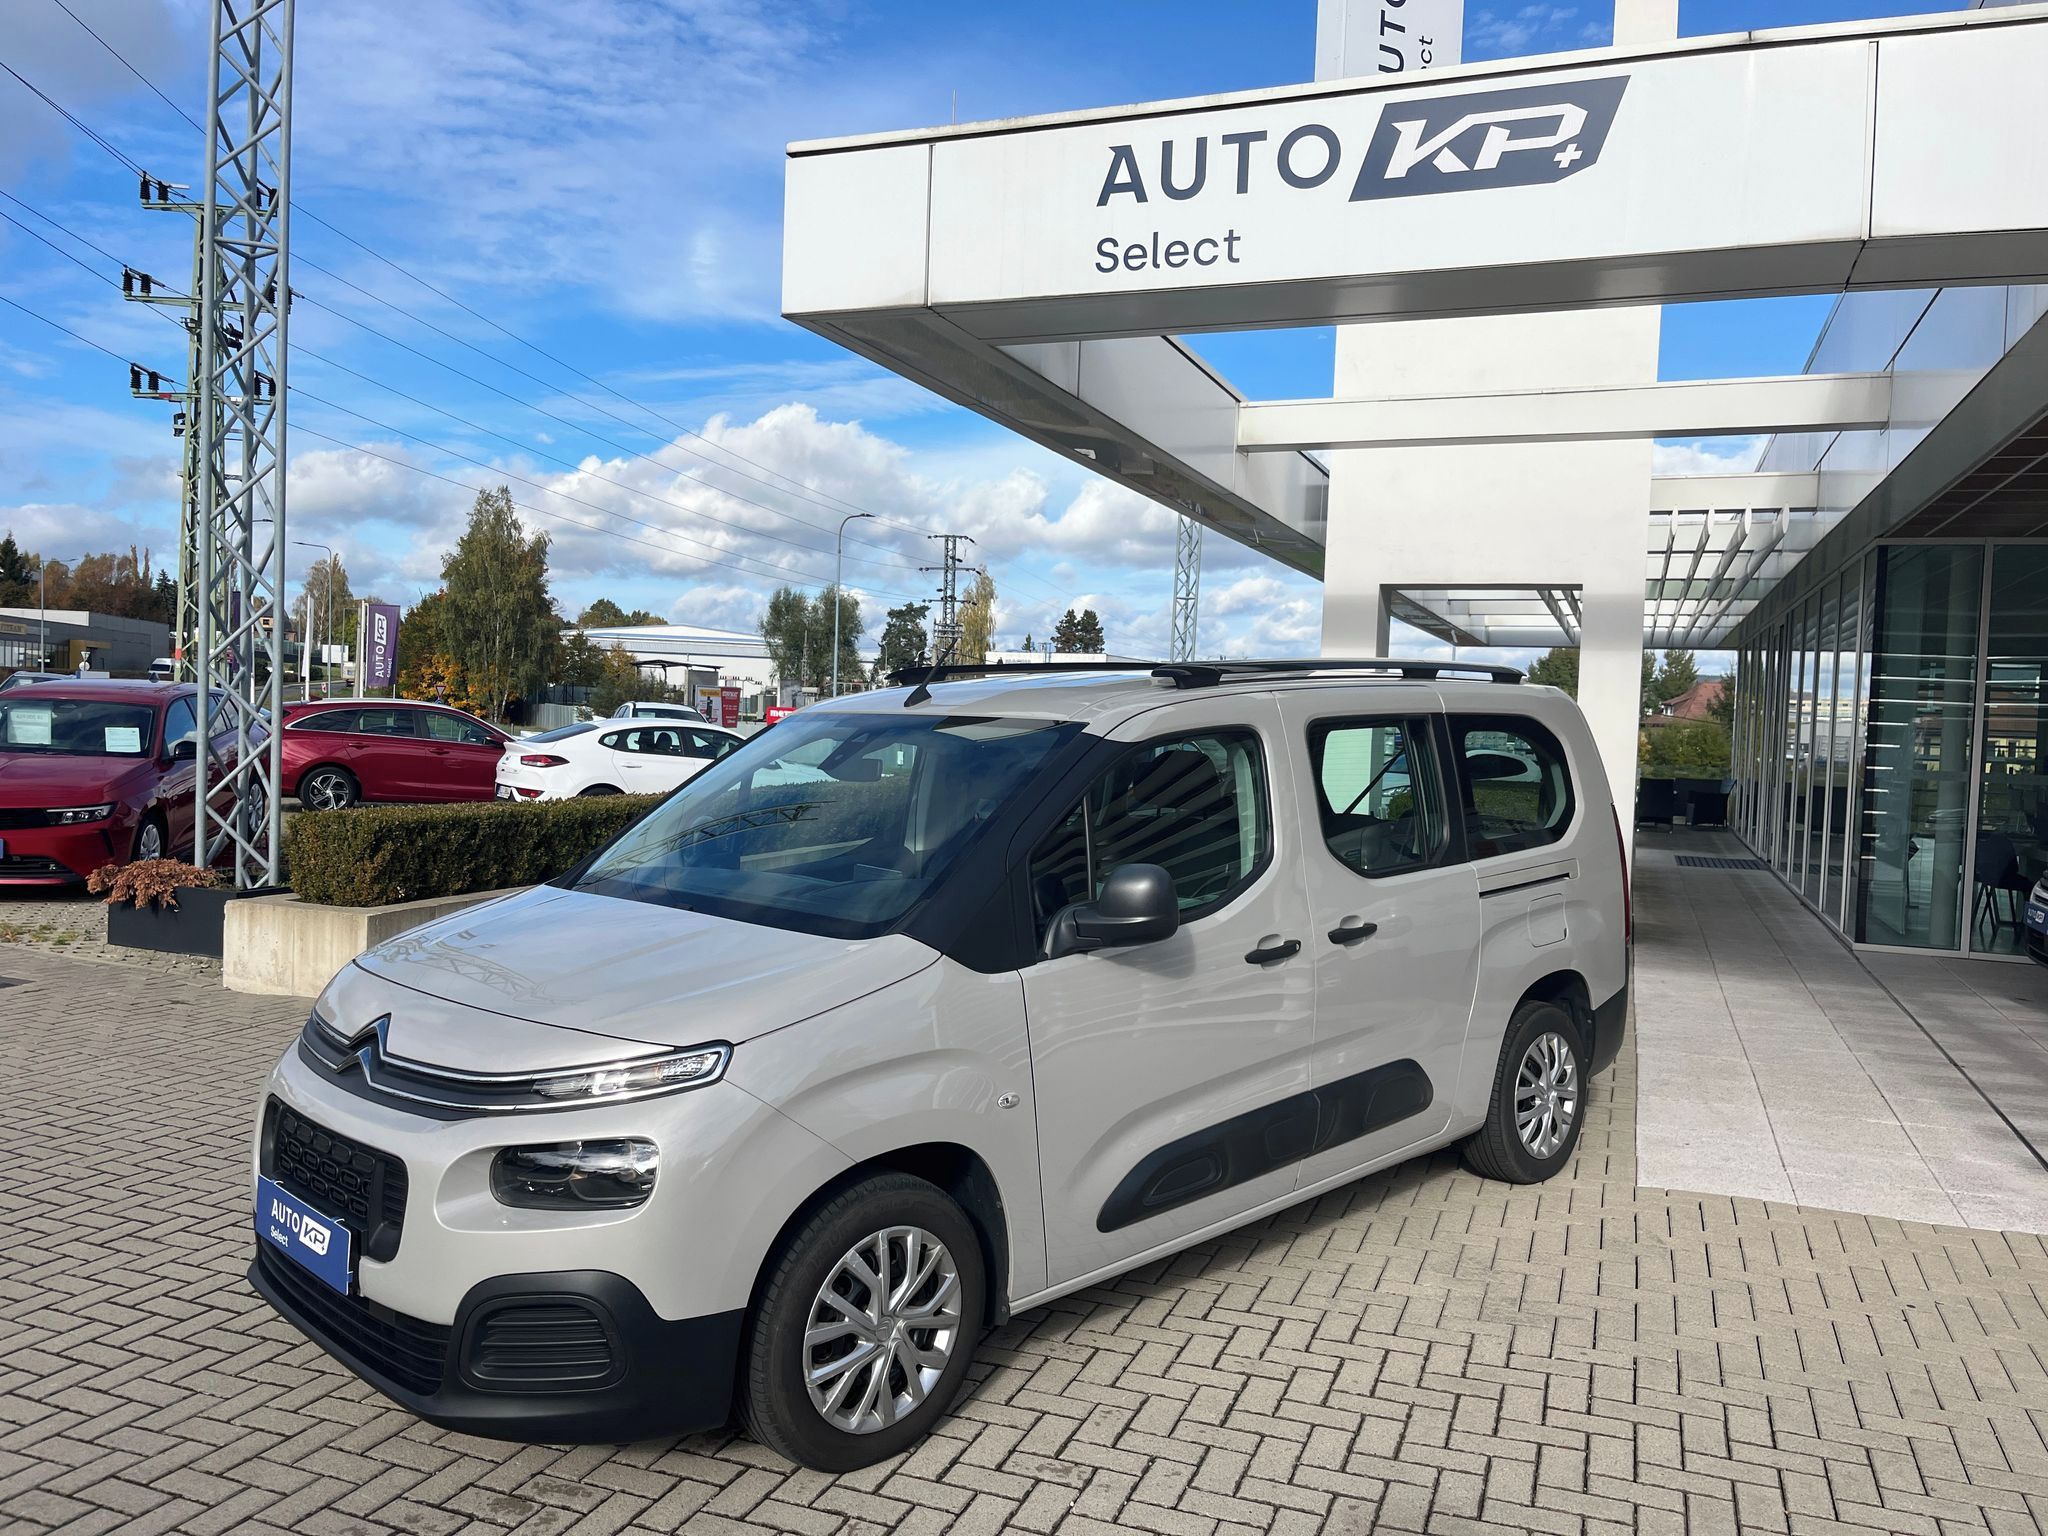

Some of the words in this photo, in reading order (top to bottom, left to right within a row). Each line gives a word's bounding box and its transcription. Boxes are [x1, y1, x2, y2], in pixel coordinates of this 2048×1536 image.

[1096, 124, 1341, 208] AUTO
[1095, 229, 1241, 273] Select
[375, 645, 385, 678] AUTO
[271, 1198, 300, 1233] AUTO
[270, 1225, 289, 1248] Select
